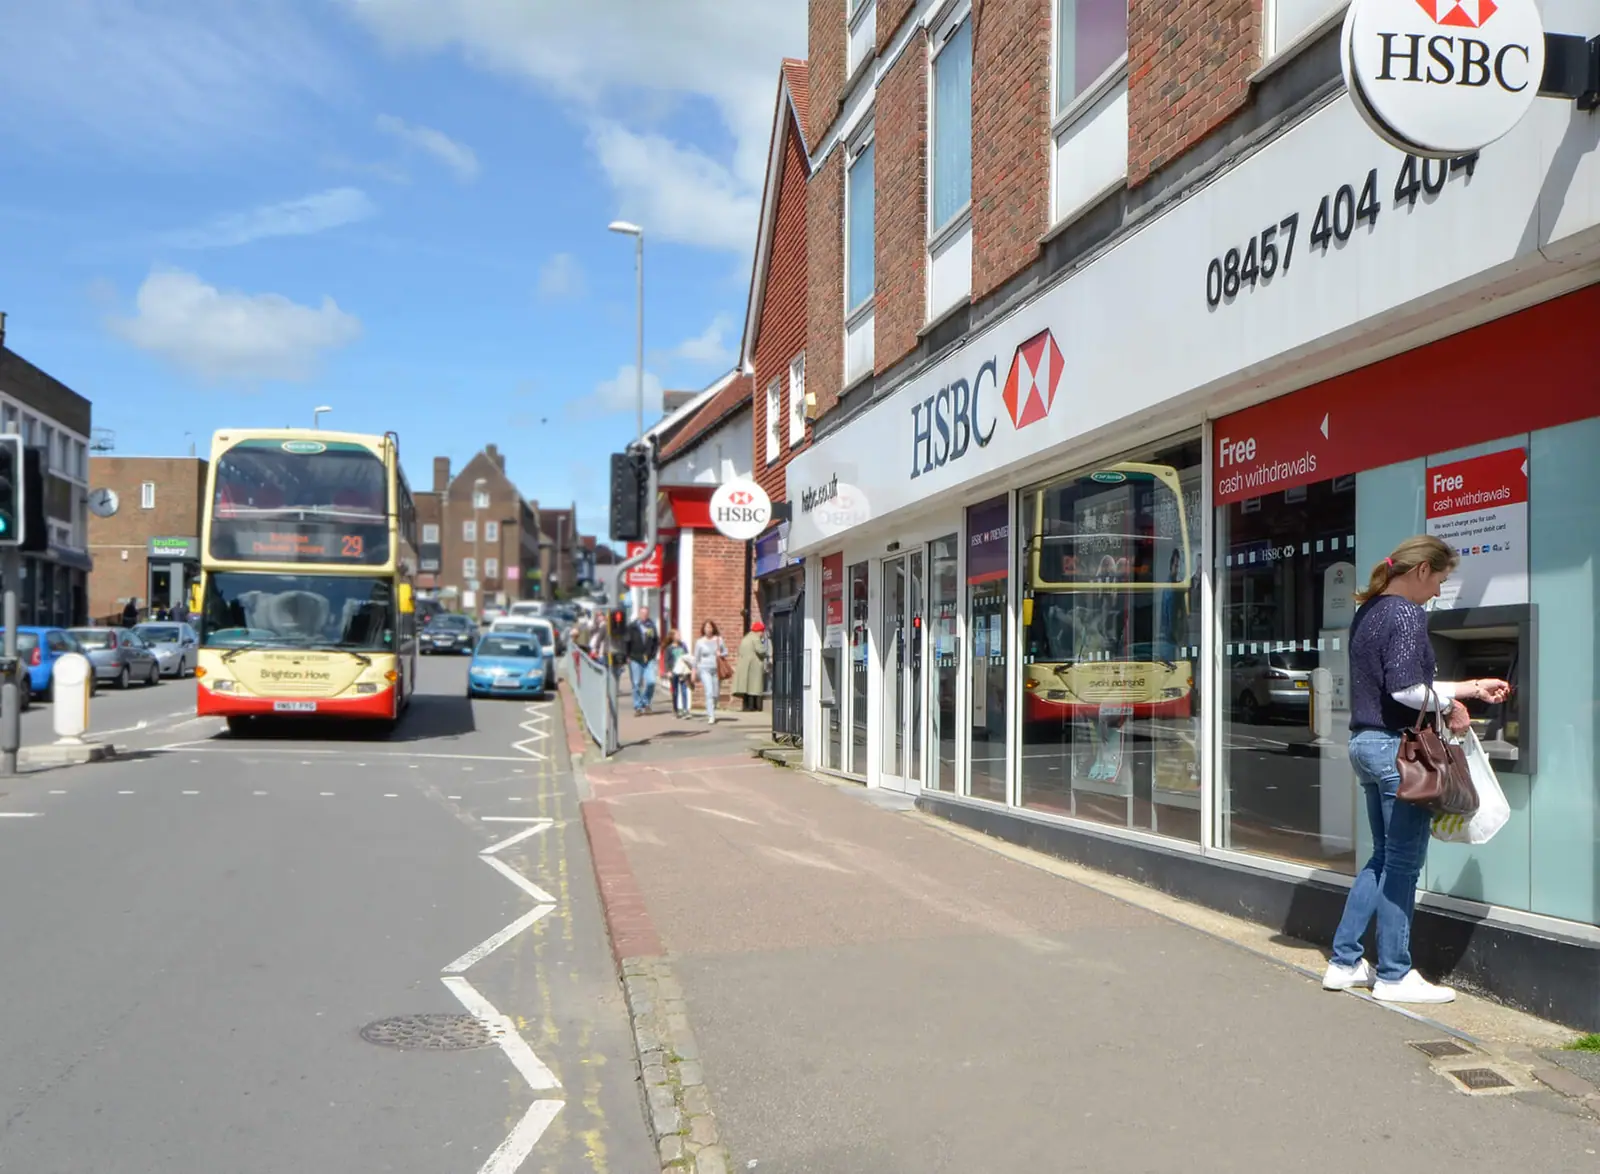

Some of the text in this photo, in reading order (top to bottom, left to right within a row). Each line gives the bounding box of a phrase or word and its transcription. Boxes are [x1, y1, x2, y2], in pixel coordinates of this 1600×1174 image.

[1375, 32, 1530, 93] HSBC
[1206, 212, 1299, 306] 08457
[1310, 168, 1381, 250] 404
[910, 354, 997, 480] HSBC
[1219, 437, 1257, 468] Free
[1218, 450, 1317, 495] cash withdrawals
[1433, 473, 1464, 494] Free
[1433, 485, 1511, 512] cash withdrawals
[717, 506, 766, 523] HSBC
[1455, 519, 1469, 527] charge
[1485, 514, 1497, 522] cash
[1473, 527, 1483, 536] your
[1483, 525, 1496, 533] debit
[1496, 523, 1507, 531] card
[341, 535, 363, 557] 29
[1262, 547, 1284, 561] HSBC
[260, 668, 330, 681] Brighton Hove
